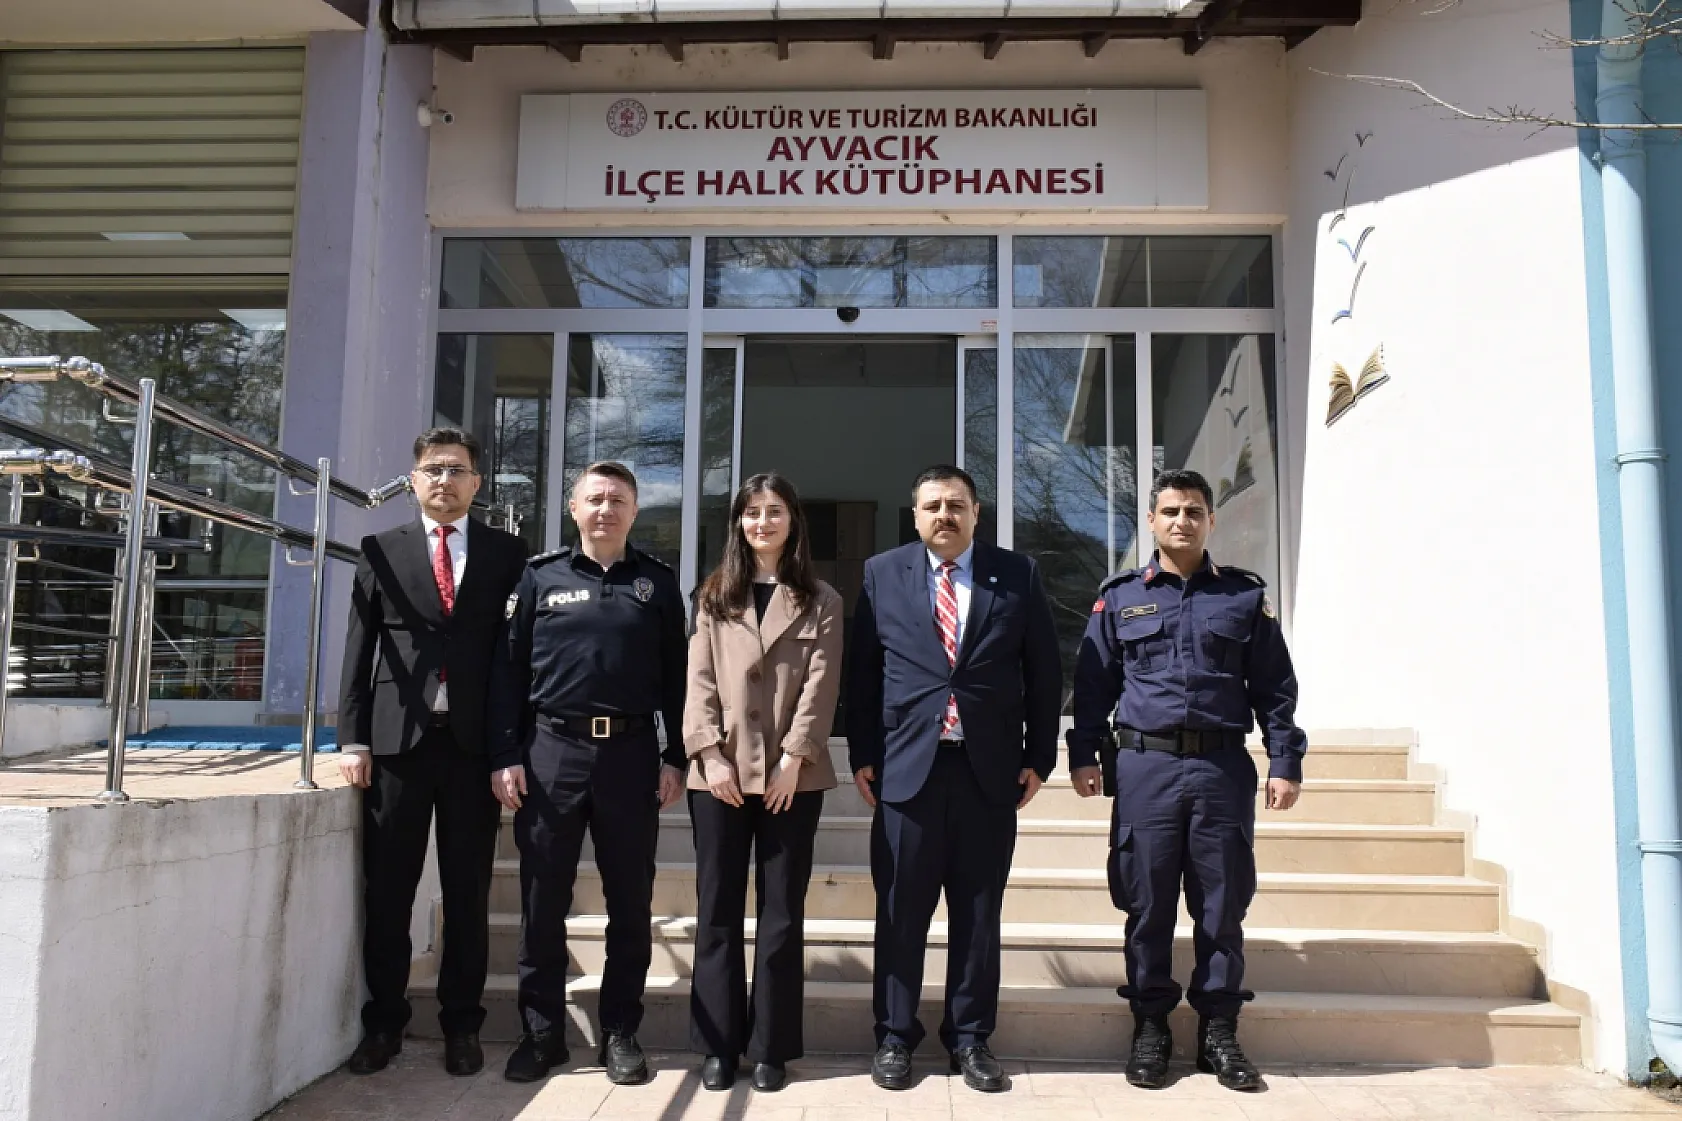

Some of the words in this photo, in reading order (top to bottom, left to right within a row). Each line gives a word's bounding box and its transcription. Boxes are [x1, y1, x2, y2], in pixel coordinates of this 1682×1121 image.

[654, 110, 698, 130] T.C.
[705, 105, 804, 130] KÜLTÜR
[809, 109, 841, 129] VE
[847, 104, 947, 129] TURİZM
[955, 103, 1098, 129] BAKANLIĞI
[766, 135, 940, 161] AYVACIK
[605, 164, 685, 204] İLÇE
[697, 169, 804, 196] HALK
[815, 162, 1104, 196] KÜTÜPHANESİ
